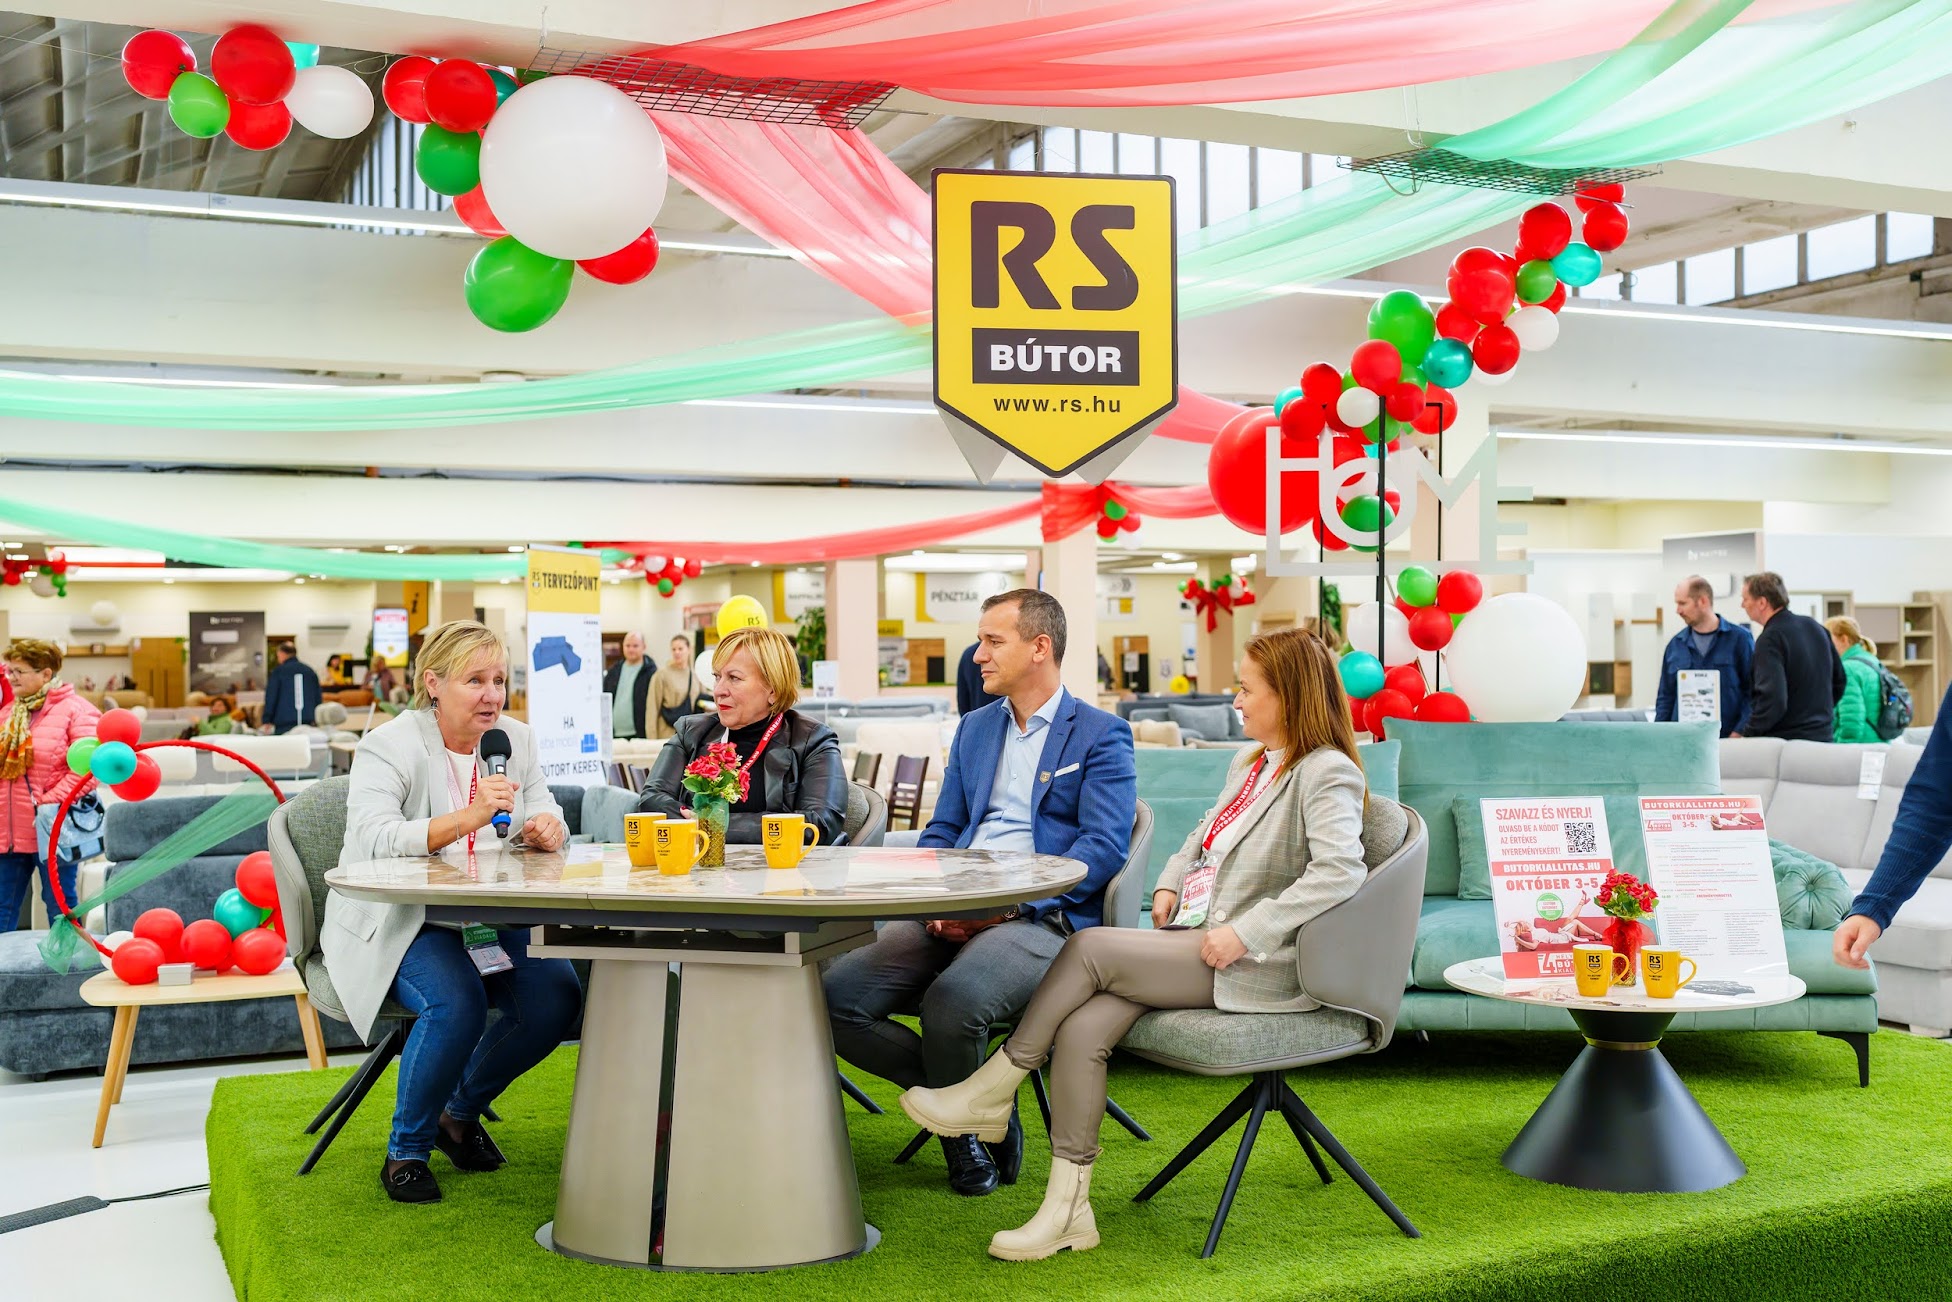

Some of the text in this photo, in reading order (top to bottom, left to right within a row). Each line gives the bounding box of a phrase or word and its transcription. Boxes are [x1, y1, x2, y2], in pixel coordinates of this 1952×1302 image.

[971, 200, 1139, 311] RS
[990, 338, 1122, 373] BÚTOR
[993, 396, 1121, 413] www.rs.hu
[541, 570, 599, 592] TERVEZŐPONT
[930, 588, 978, 602] PÉNZTÁR
[747, 616, 760, 626] RS
[563, 716, 575, 730] HA
[1644, 801, 1741, 809] BUTORKIALLITAS.HU
[1495, 804, 1593, 820] SZAVAZZ ÉS NYERJ!
[1672, 812, 1705, 820] OKTÓBER
[628, 821, 638, 829] RS
[768, 823, 779, 831] RS
[1498, 823, 1559, 833] OLVASD BE A KÓDOT
[657, 829, 668, 837] RS
[1500, 834, 1538, 844] AZ ÉRTÉKES
[1501, 846, 1561, 856] NYEREMÉNYEKÉRT!
[1503, 861, 1601, 873] BUTORKIALLITAS.HU
[1505, 876, 1570, 891] OKTÓBER
[1588, 955, 1600, 963] RS
[1649, 955, 1661, 964] RS
